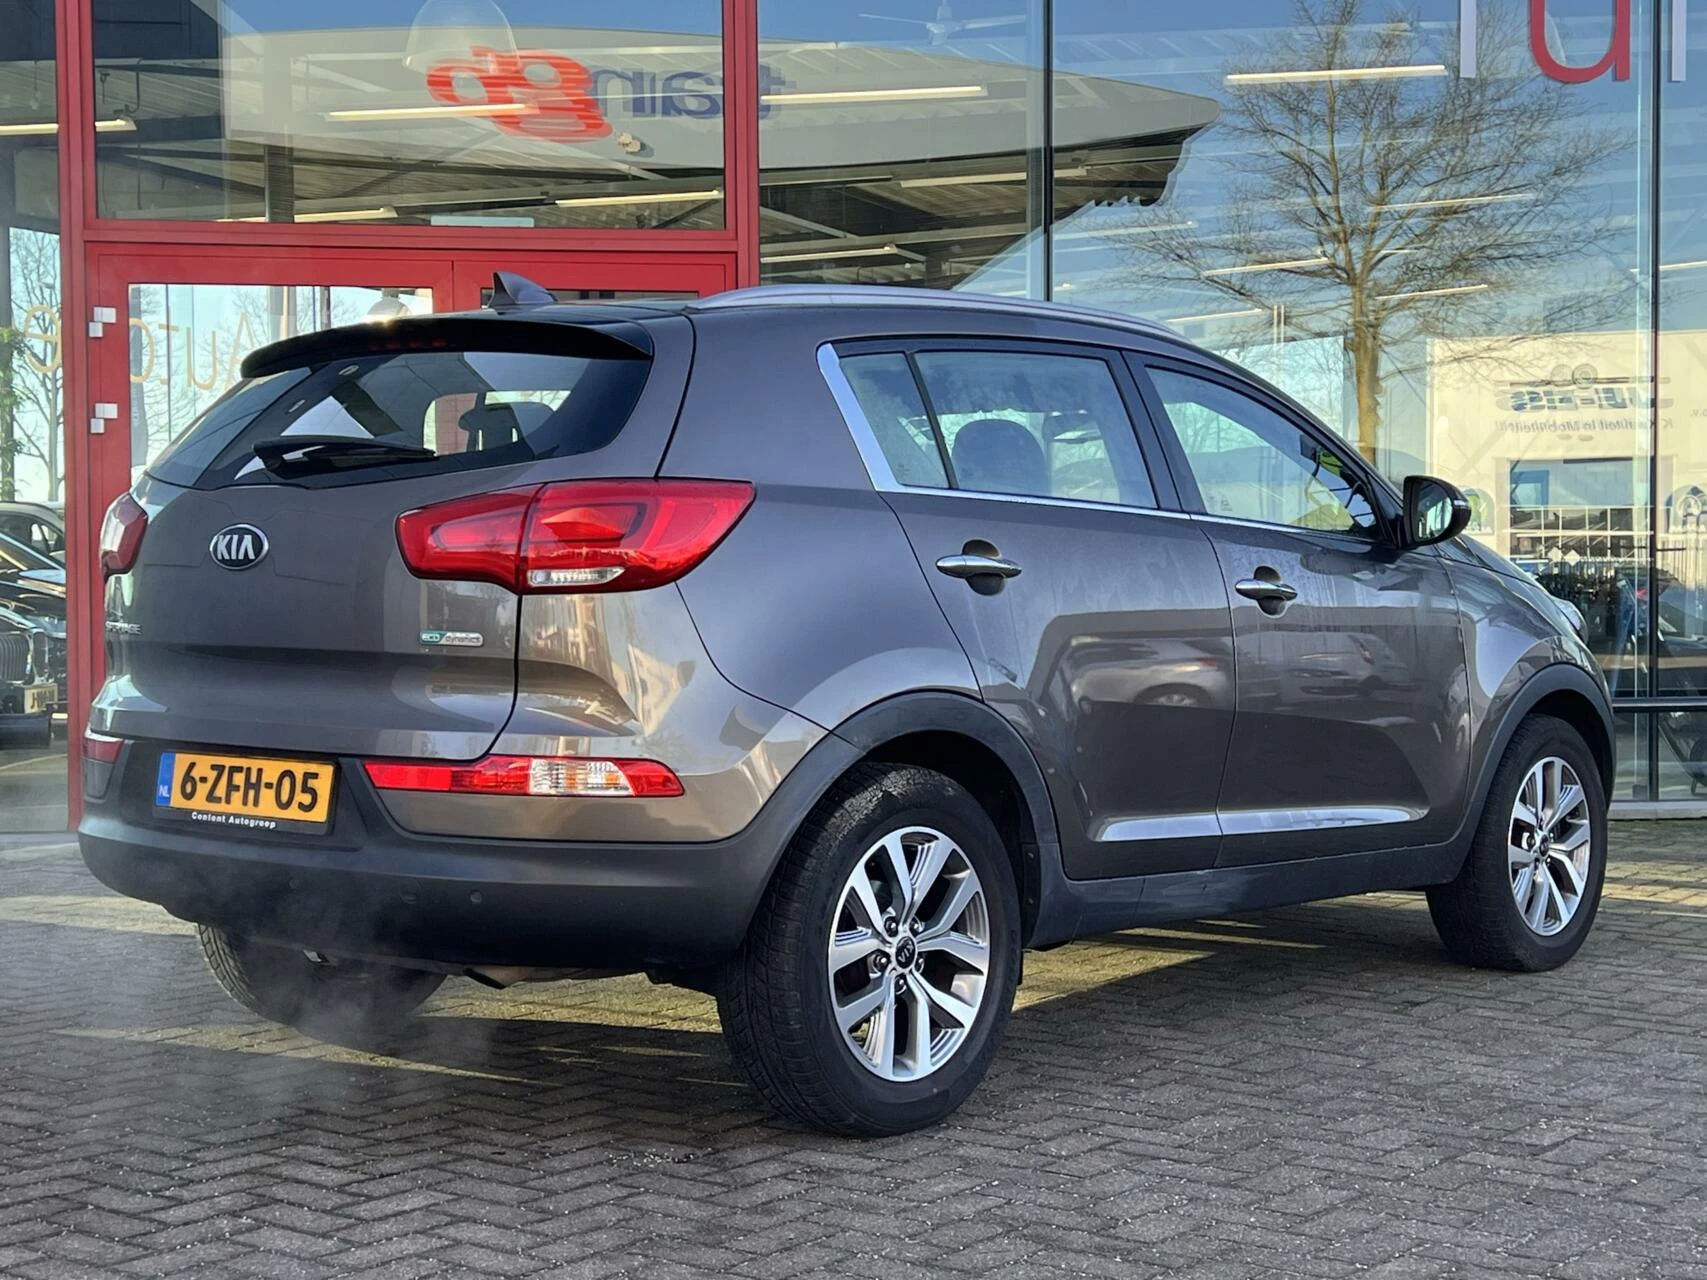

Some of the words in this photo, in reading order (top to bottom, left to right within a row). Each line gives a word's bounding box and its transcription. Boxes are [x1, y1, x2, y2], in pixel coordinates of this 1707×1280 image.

[216, 534, 256, 560] KIA
[159, 785, 170, 798] NL
[180, 761, 319, 813] 6-ZFH-05
